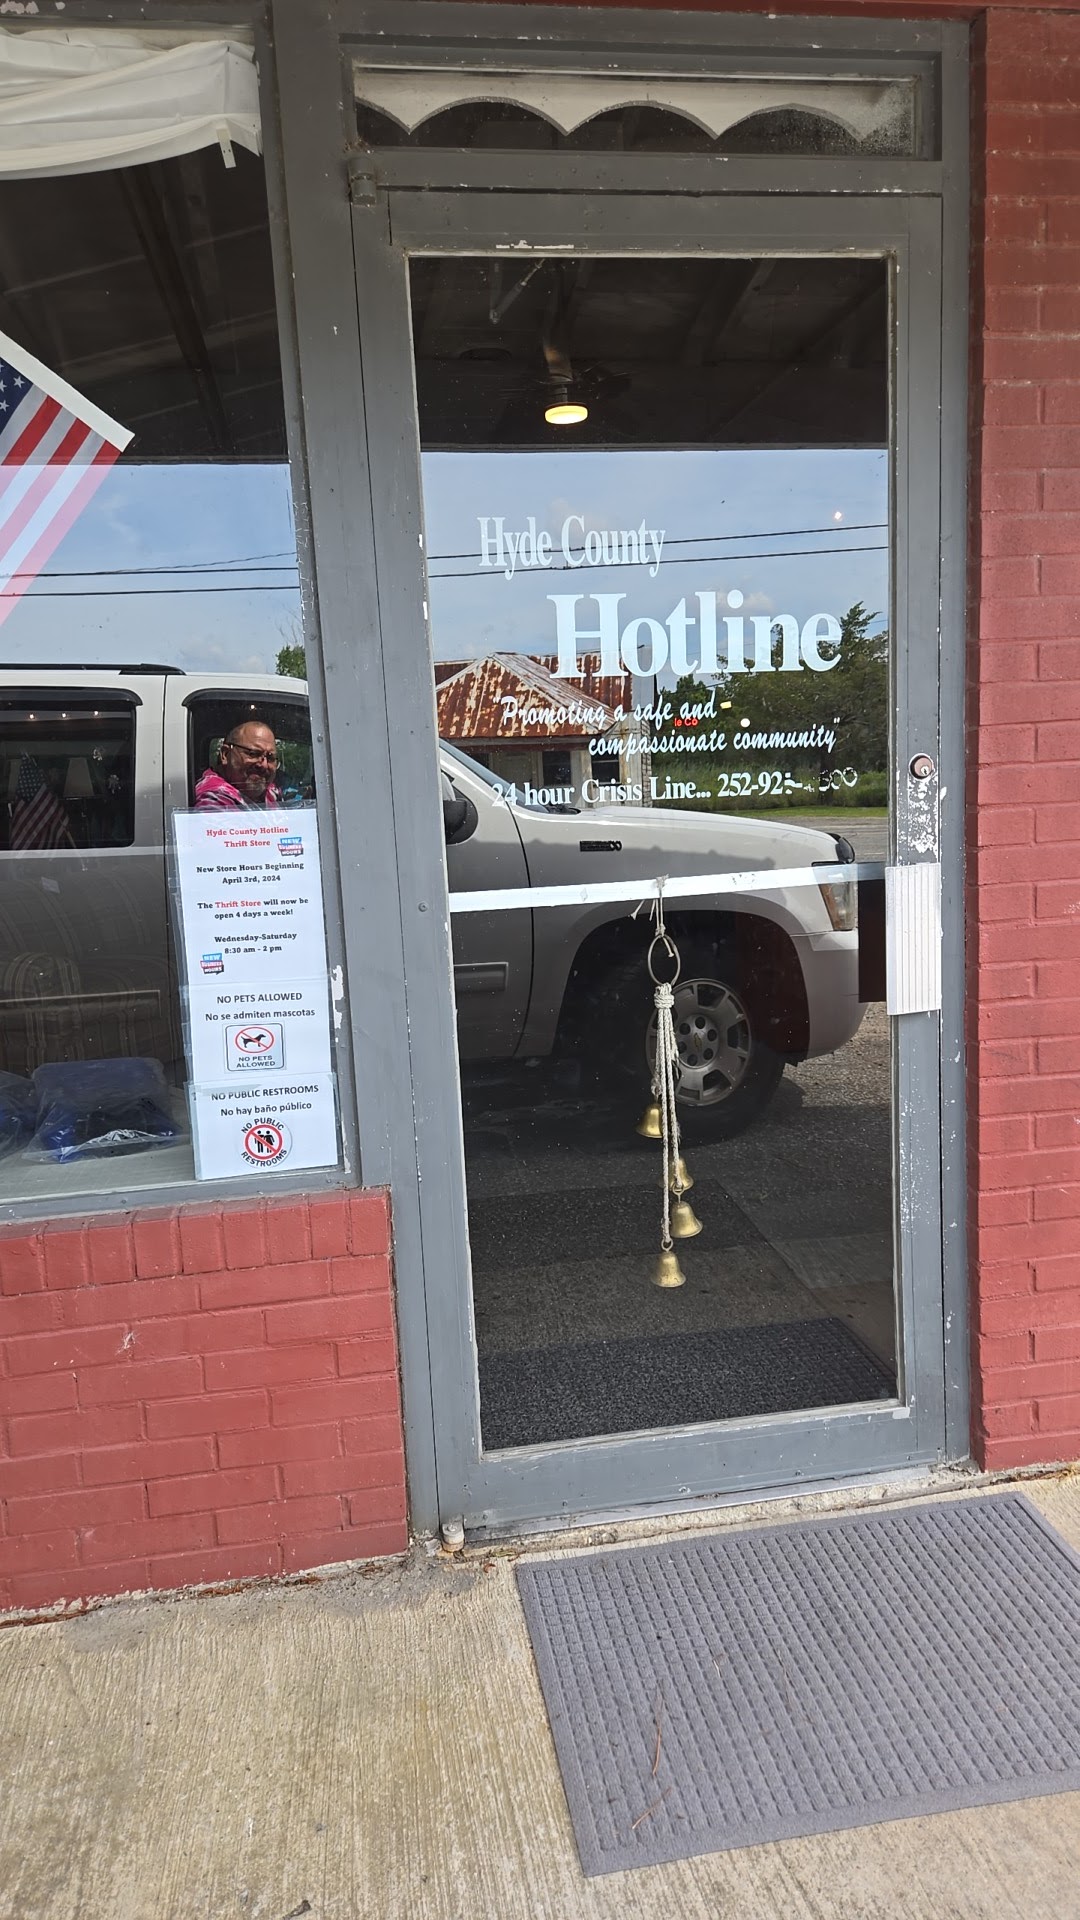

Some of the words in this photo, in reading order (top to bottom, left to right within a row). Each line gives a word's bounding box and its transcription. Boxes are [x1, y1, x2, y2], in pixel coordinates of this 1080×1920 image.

[477, 516, 553, 580] Hyde
[561, 515, 666, 578] County
[546, 589, 842, 680] Hotline
[493, 694, 607, 726] "Promoting
[613, 705, 627, 722] a
[633, 692, 674, 730] safe
[680, 691, 717, 720] and
[588, 729, 727, 763] compassionate
[733, 717, 841, 753] community"
[491, 782, 517, 807] 24
[524, 781, 575, 806] hour
[581, 777, 642, 804] Crisis
[649, 775, 711, 801] Line...
[207, 828, 227, 837] Hyde
[229, 827, 258, 837] County
[260, 826, 289, 835] Hotline
[224, 840, 248, 848] Thrift
[250, 839, 270, 847] Store
[216, 865, 237, 873] Store
[239, 864, 263, 872] Hours
[265, 862, 304, 871] Beginning
[222, 876, 242, 885] April
[244, 875, 260, 884] 3rd,
[215, 901, 238, 909] Thrift
[243, 911, 261, 919] days
[214, 932, 297, 943] Wednesday-Saturday
[217, 996, 231, 1004] NO
[234, 994, 256, 1003] PETS
[258, 992, 303, 1002] ALLOWED
[205, 1013, 219, 1021] No
[233, 1011, 271, 1020] admiten
[273, 1009, 315, 1018] mascotas
[211, 1092, 226, 1101] NO
[228, 1089, 261, 1099] PUBLIC
[262, 1084, 319, 1097] RESTROOMS
[220, 1108, 233, 1116] No
[235, 1106, 252, 1116] hay
[254, 1103, 277, 1113] baño
[279, 1101, 312, 1113] público
[241, 1122, 253, 1134] NO
[253, 1117, 284, 1131] PUBLIC
[240, 1148, 288, 1167] RESTROOMS
